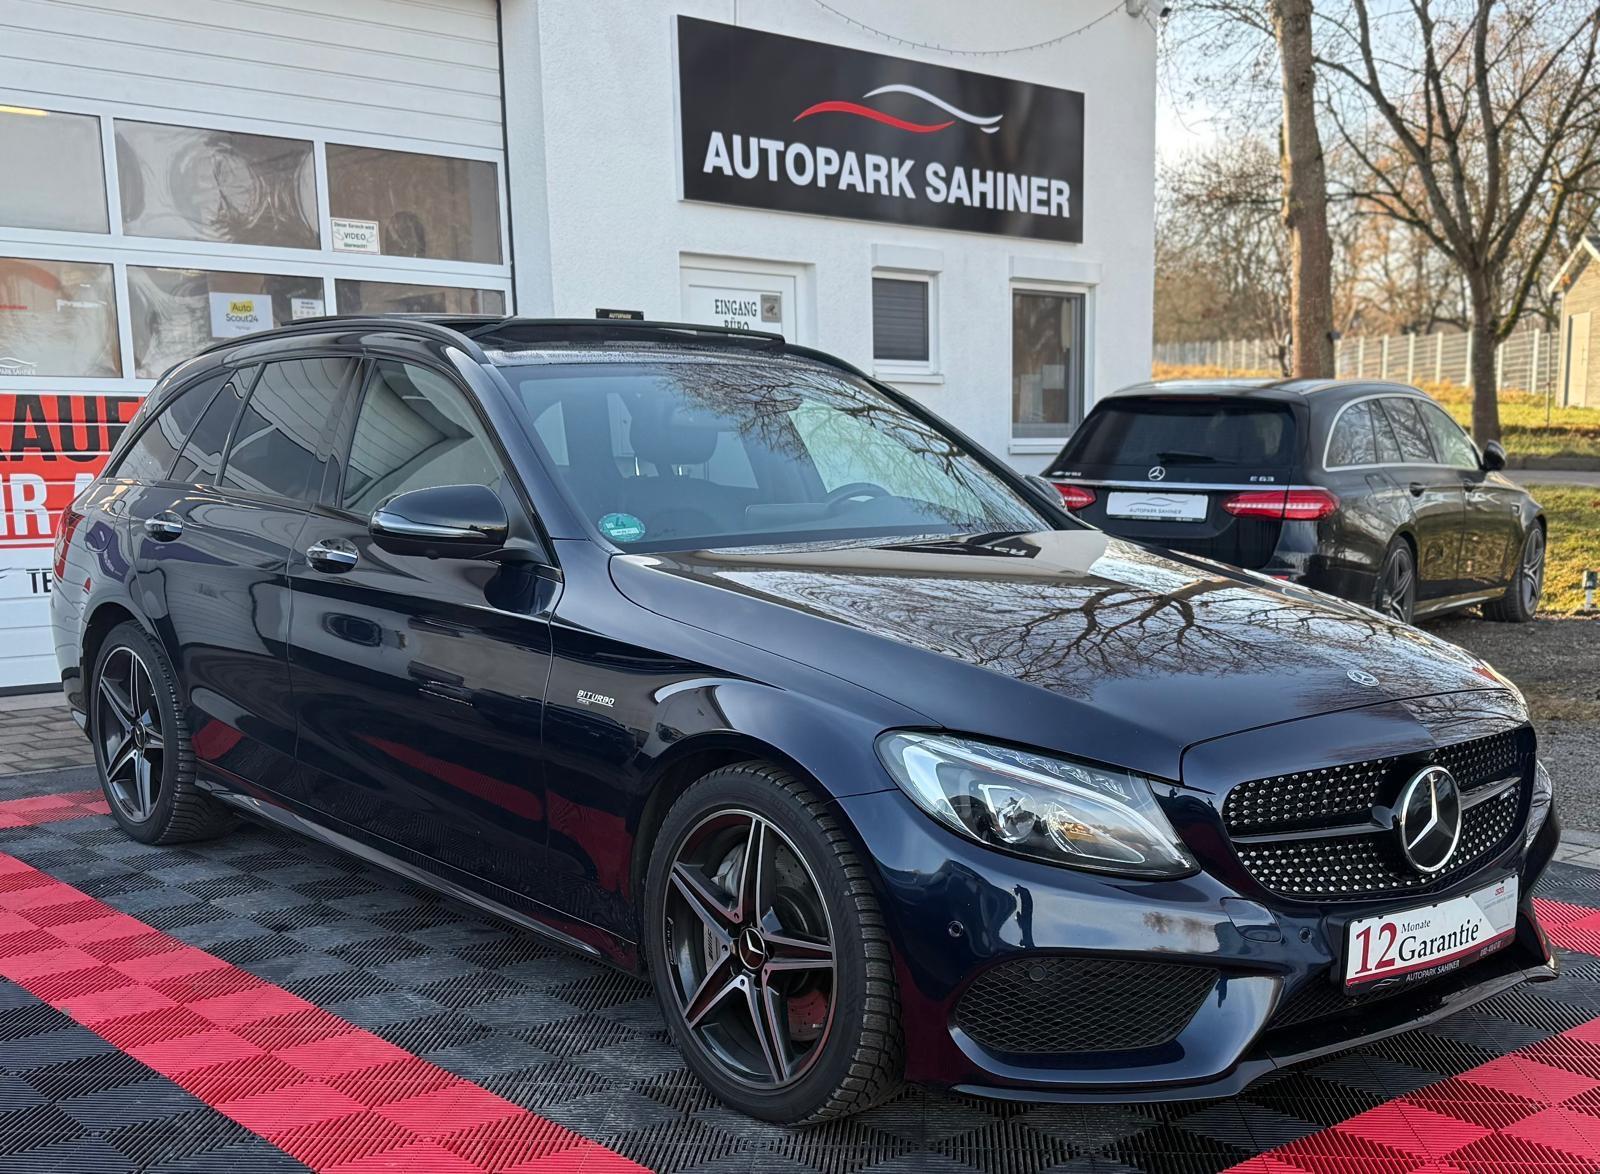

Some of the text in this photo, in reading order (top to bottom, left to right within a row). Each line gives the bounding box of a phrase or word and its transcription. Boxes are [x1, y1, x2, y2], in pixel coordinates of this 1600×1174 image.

[703, 131, 1070, 218] AUTOPARK SAHINER
[344, 232, 366, 240] VIDEO
[232, 303, 252, 312] Auto
[715, 299, 757, 317] EINGANG
[225, 313, 258, 322] Scout24
[0, 395, 139, 462] AUF
[577, 690, 615, 705] BITURBO
[1401, 918, 1431, 934] Monate
[1355, 922, 1398, 975] 12
[1405, 959, 1460, 983] AUTOPARK SAHINER
